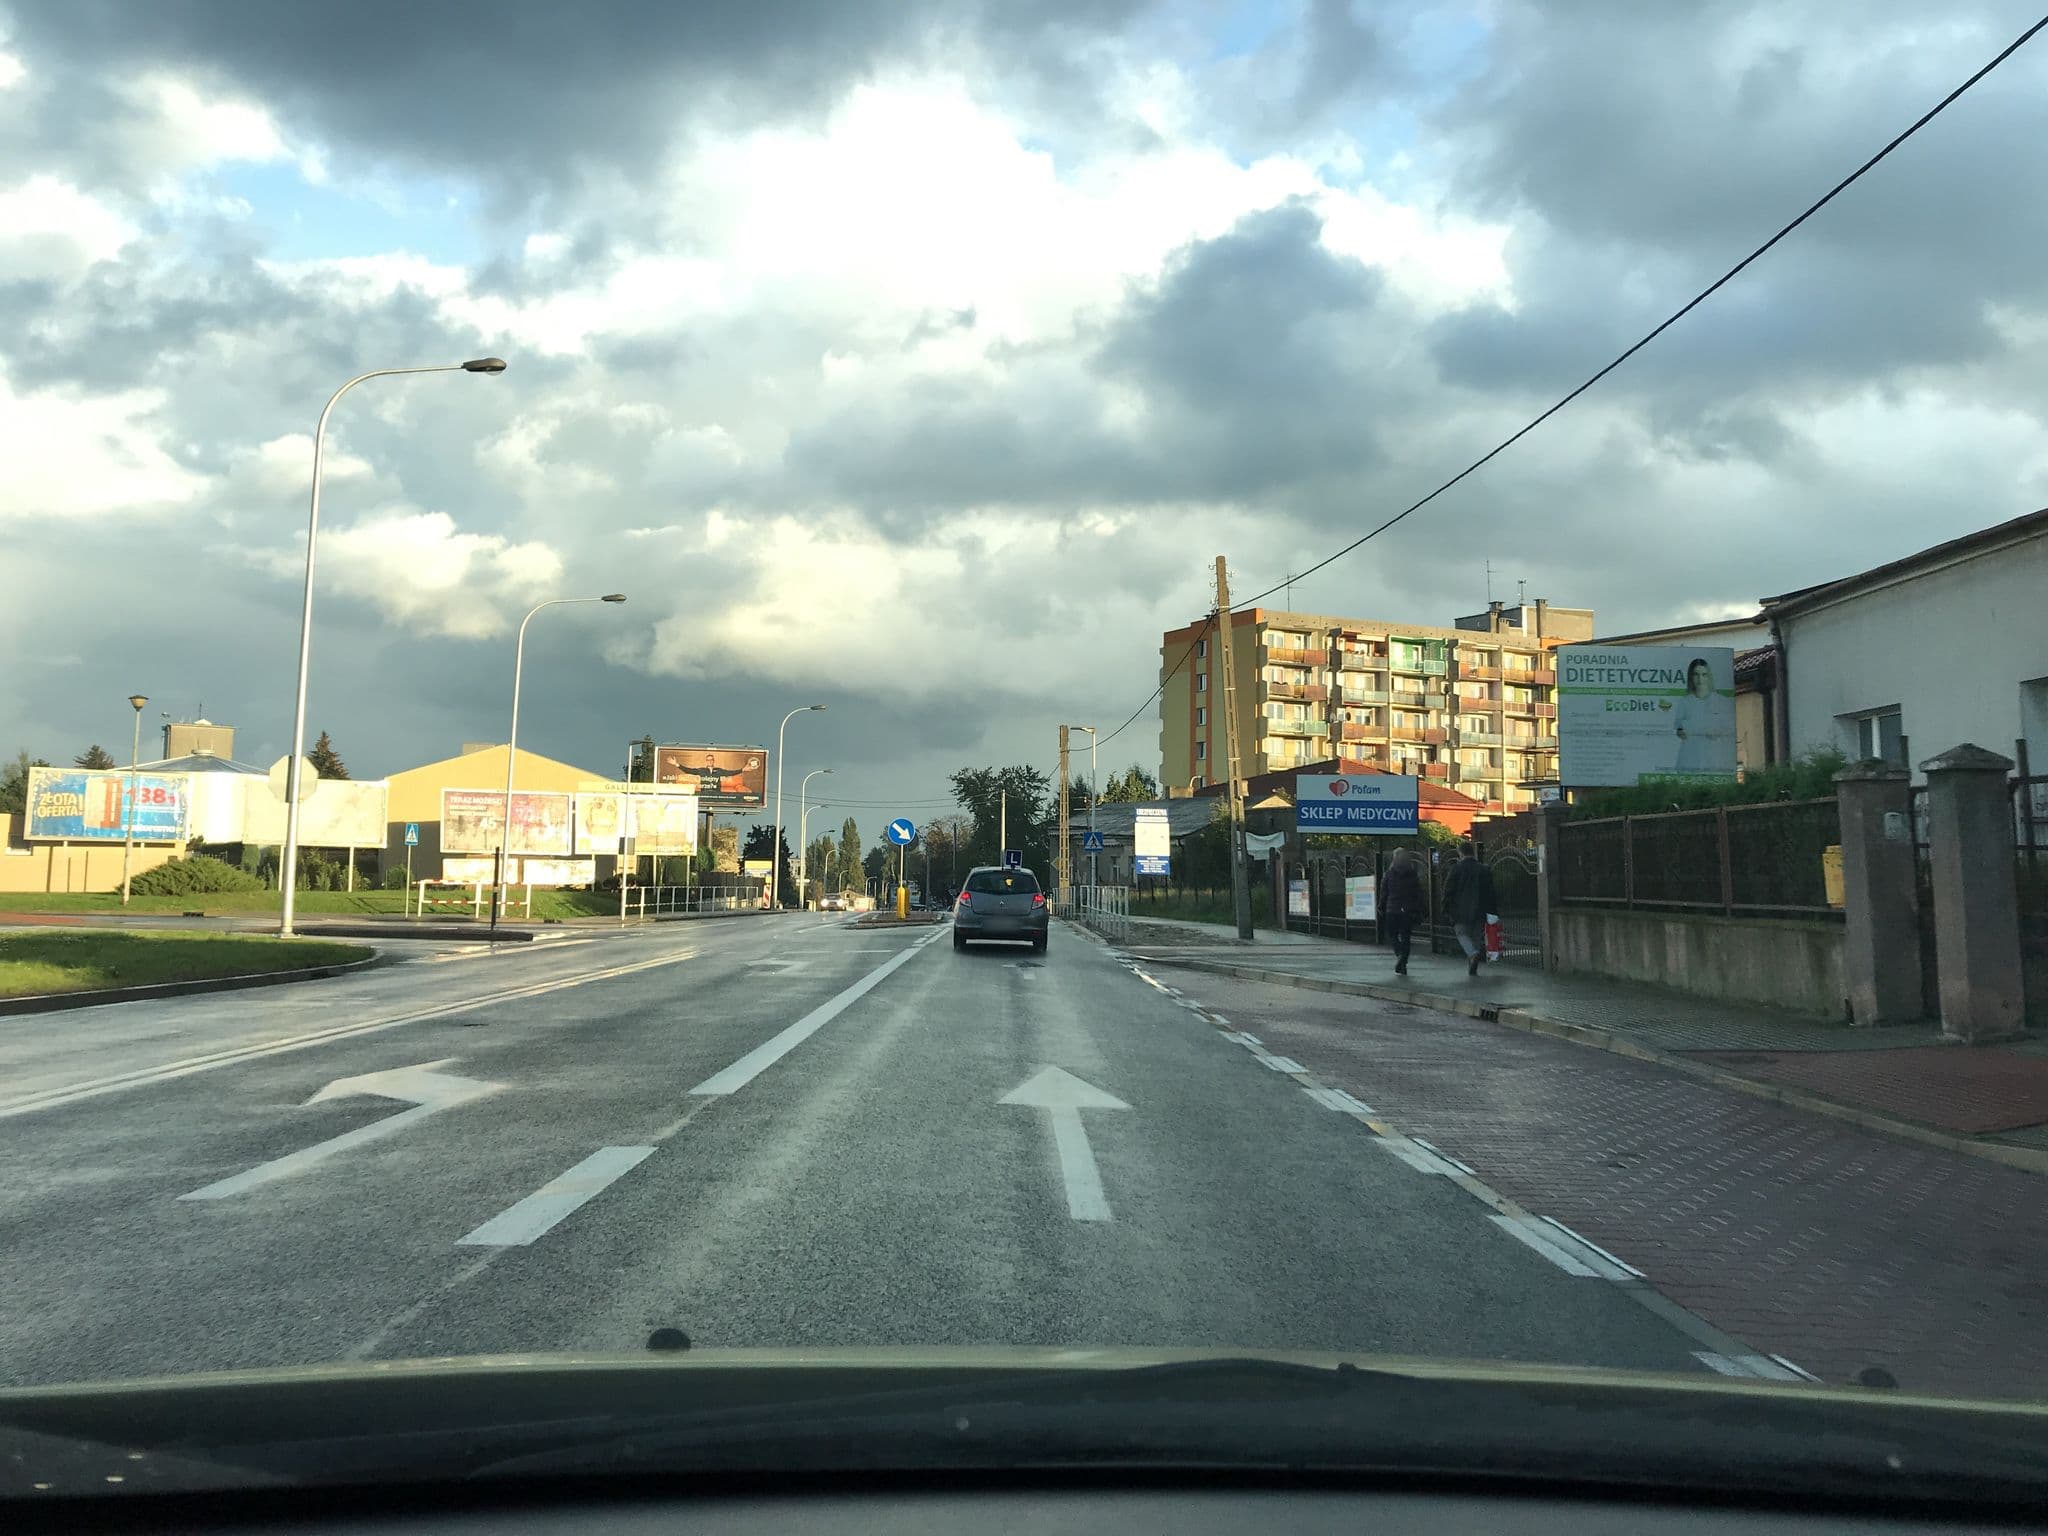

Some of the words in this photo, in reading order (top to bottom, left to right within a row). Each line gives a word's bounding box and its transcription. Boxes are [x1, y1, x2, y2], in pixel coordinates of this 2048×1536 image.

[1566, 655, 1628, 665] PORADNIA
[1566, 668, 1686, 684] DIETETYCZNA
[1605, 699, 1656, 712] EcoDiet
[604, 783, 640, 791] GALEIA
[39, 792, 77, 806] ZŁOTA
[1301, 807, 1343, 820] SKLEP
[1347, 808, 1415, 820] MEDYCZNY
[1010, 853, 1018, 864] L
